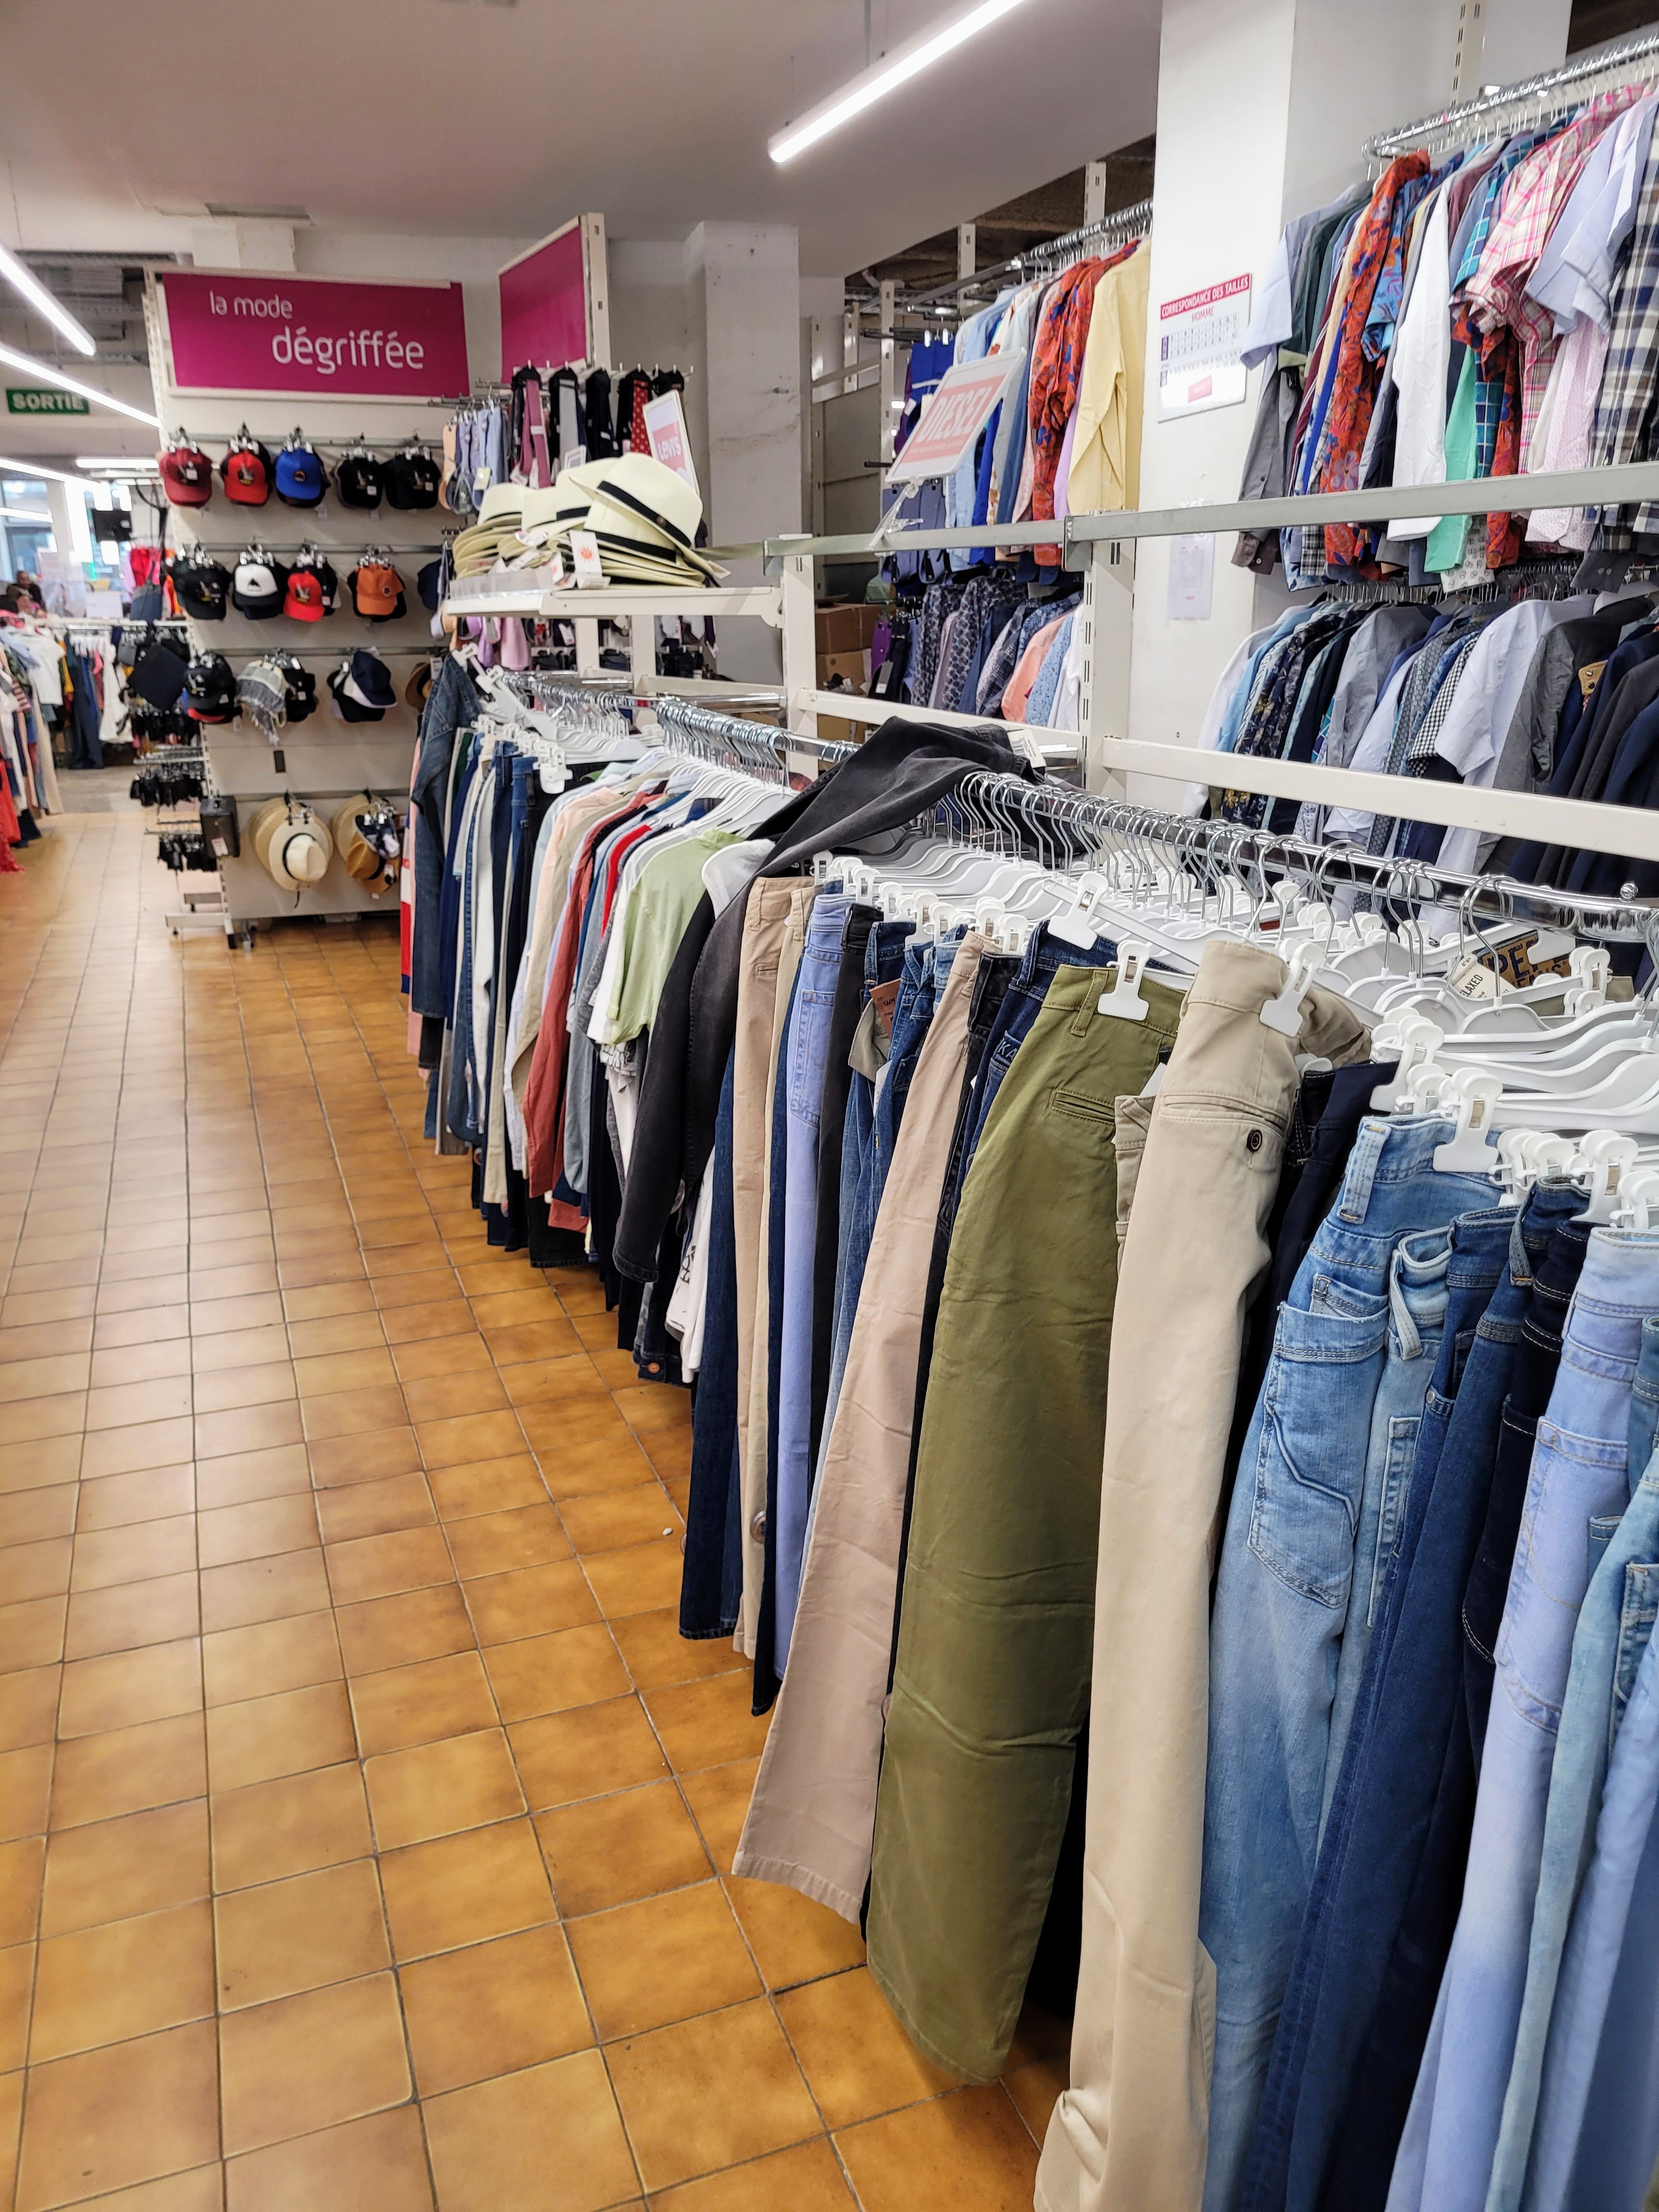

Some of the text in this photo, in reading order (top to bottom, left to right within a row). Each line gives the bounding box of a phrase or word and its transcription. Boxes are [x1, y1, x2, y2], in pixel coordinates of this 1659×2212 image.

[210, 290, 292, 319] la mode
[1161, 276, 1248, 318] CORRESPONDANCE DES TAILLES
[1192, 306, 1214, 323] HOMME
[272, 325, 424, 374] dégriffée
[916, 386, 993, 444] DIESEL
